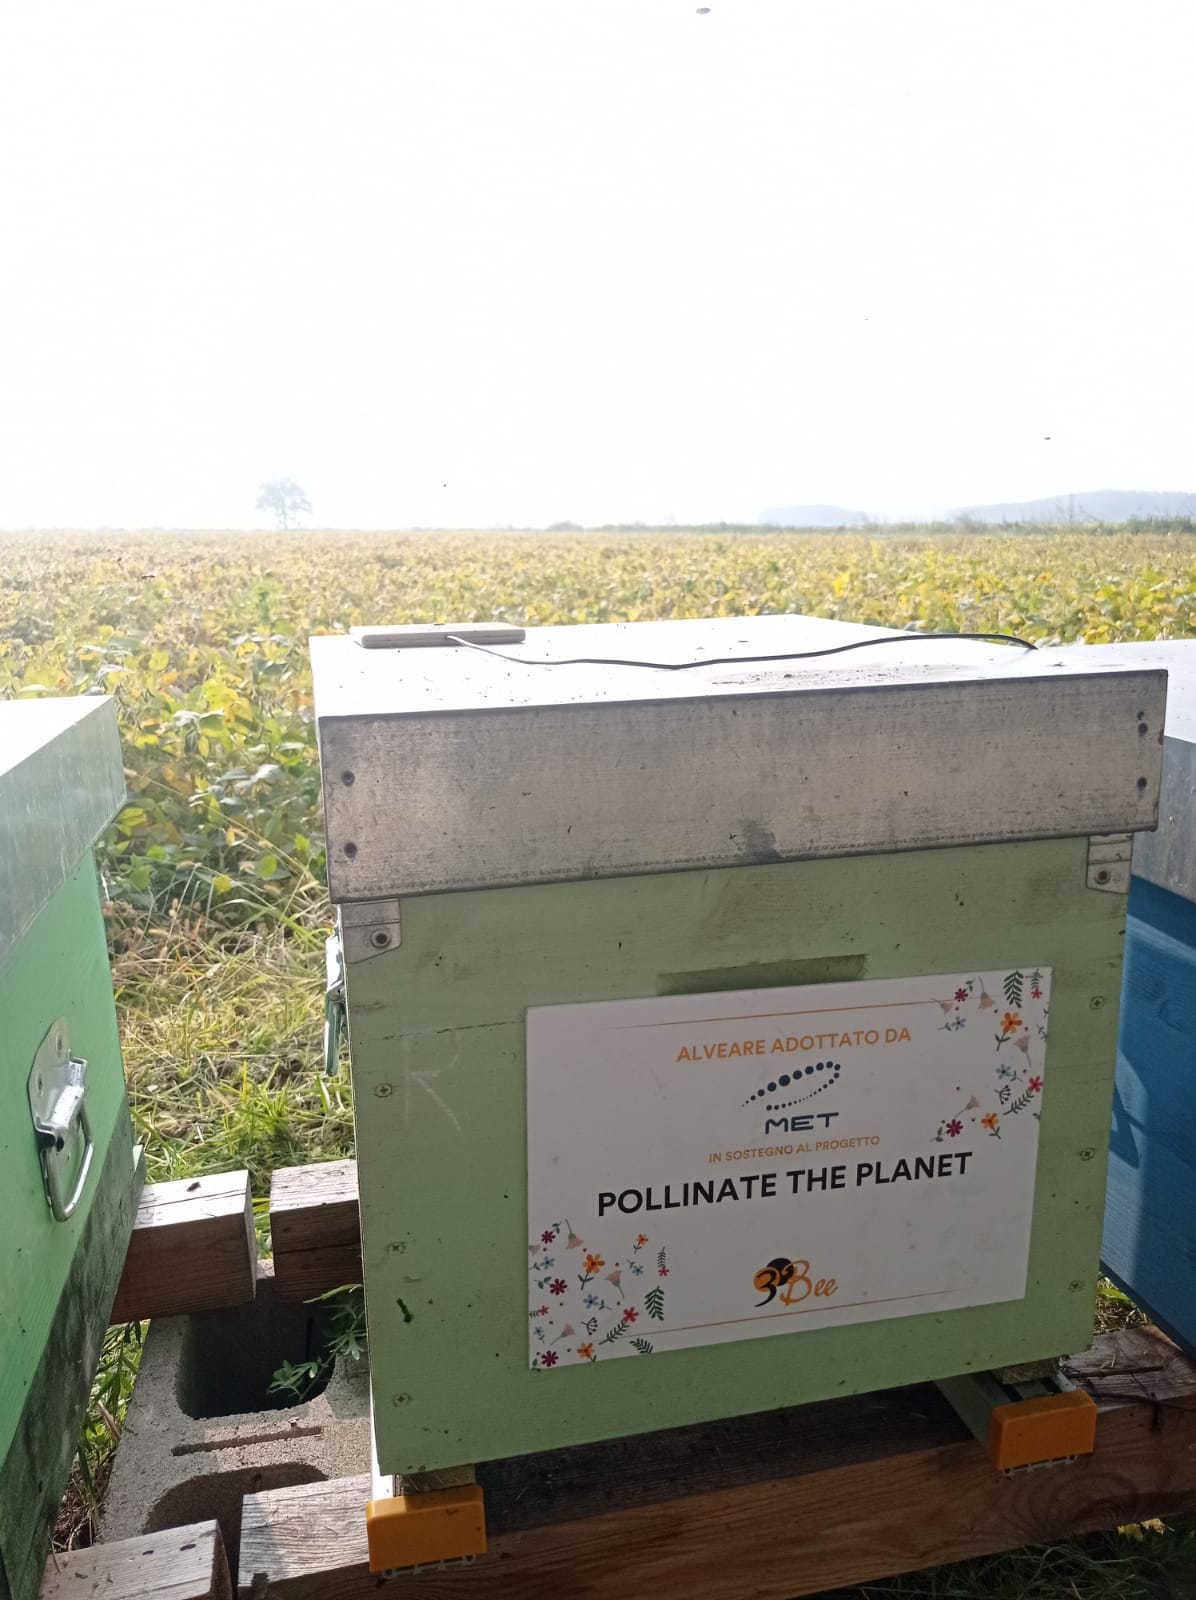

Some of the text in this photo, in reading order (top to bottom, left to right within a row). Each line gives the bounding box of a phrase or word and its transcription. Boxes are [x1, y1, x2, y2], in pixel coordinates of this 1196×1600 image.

[676, 1027, 912, 1063] ALVEARE ADOTTATO DA
[765, 1112, 840, 1136] MET
[708, 1135, 881, 1164] IN SOSTEGNO AL PROGETTO
[598, 1151, 973, 1217] POLLINATE THE PLANET
